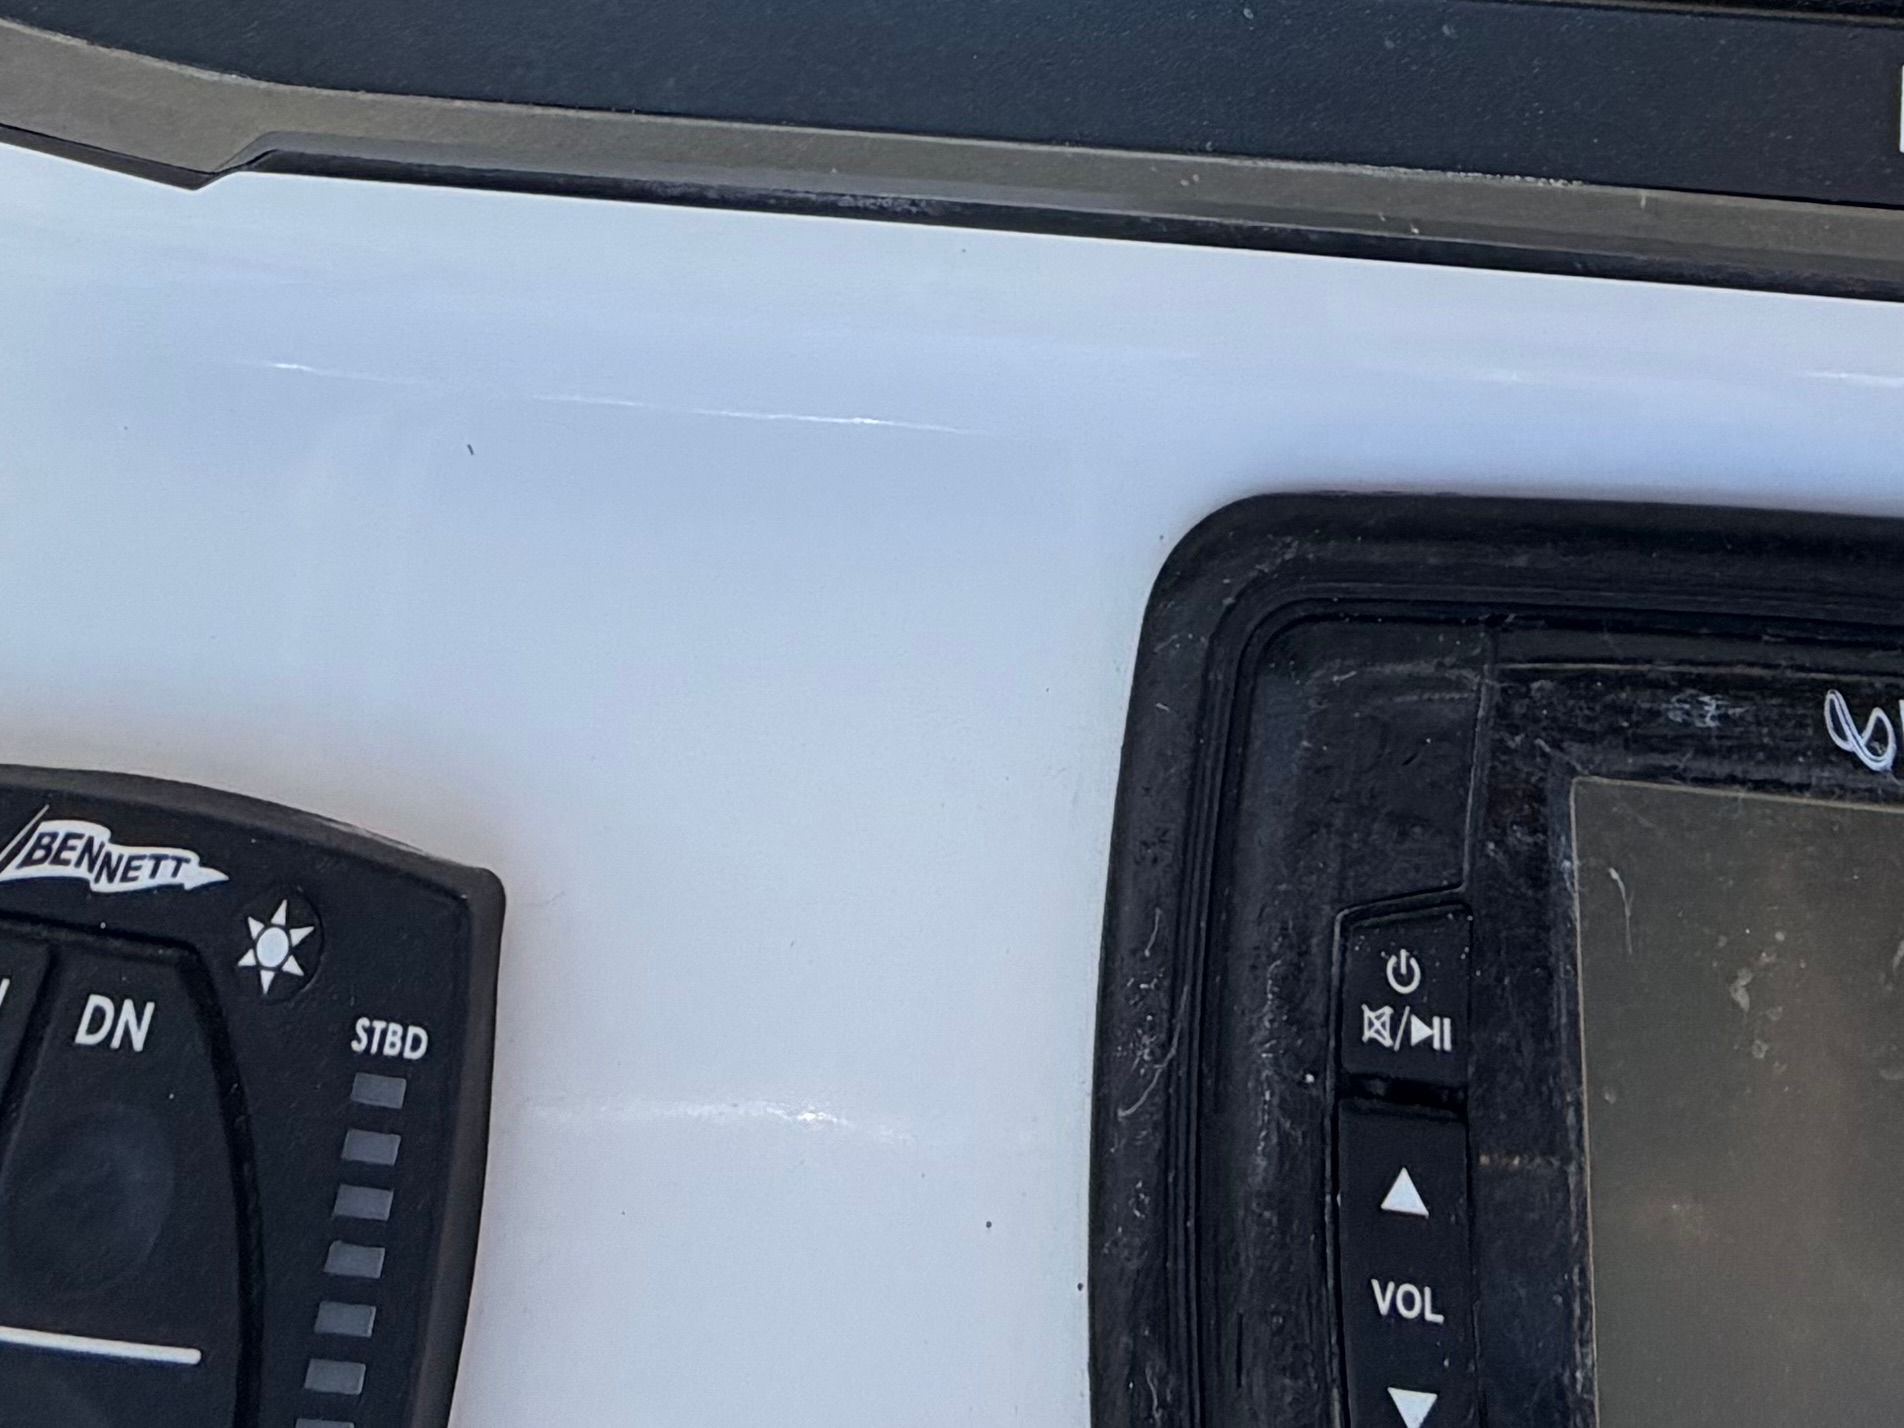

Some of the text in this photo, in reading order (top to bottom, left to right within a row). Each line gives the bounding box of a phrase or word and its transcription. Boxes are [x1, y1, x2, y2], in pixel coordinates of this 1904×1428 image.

[15, 831, 192, 885] BENNETT
[73, 993, 155, 1055] DN
[350, 1017, 428, 1061] STBD
[1371, 1277, 1445, 1325] VOL
